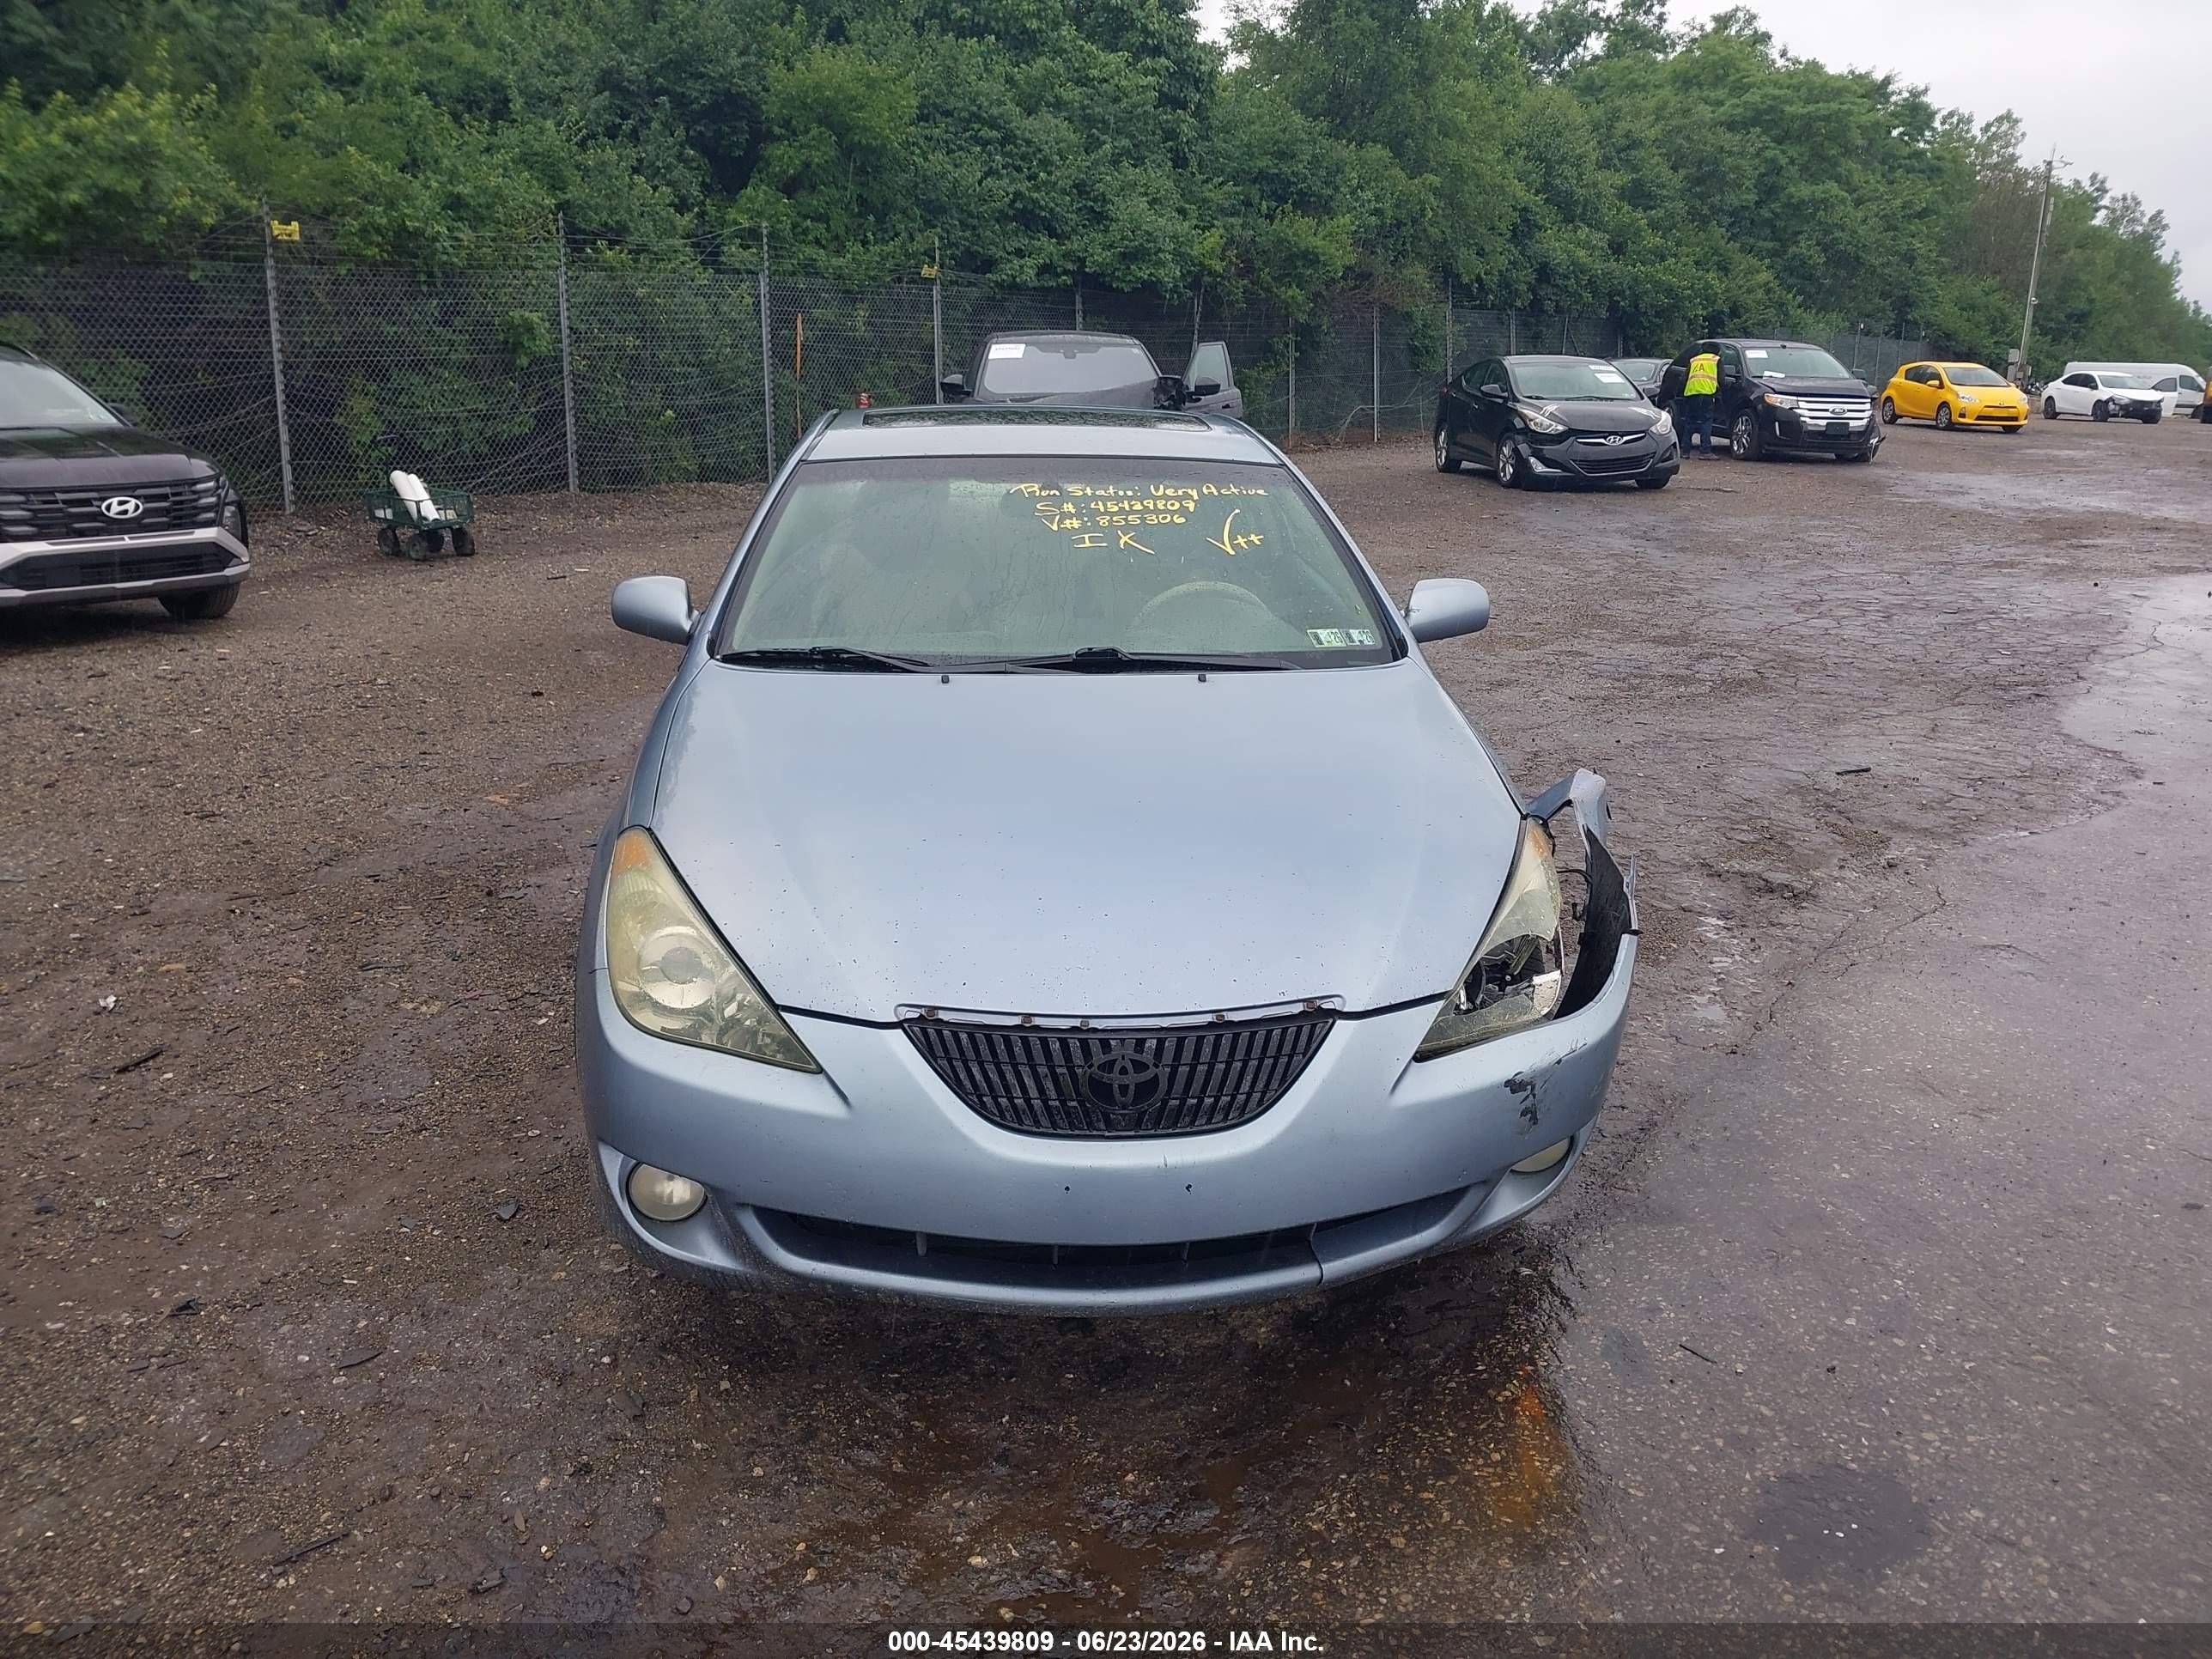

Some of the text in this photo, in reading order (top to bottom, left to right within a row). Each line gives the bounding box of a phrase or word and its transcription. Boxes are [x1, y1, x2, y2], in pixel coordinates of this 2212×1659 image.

[1150, 484, 1200, 501] Very
[1202, 483, 1269, 496] Active
[1096, 514, 1187, 527] 855306
